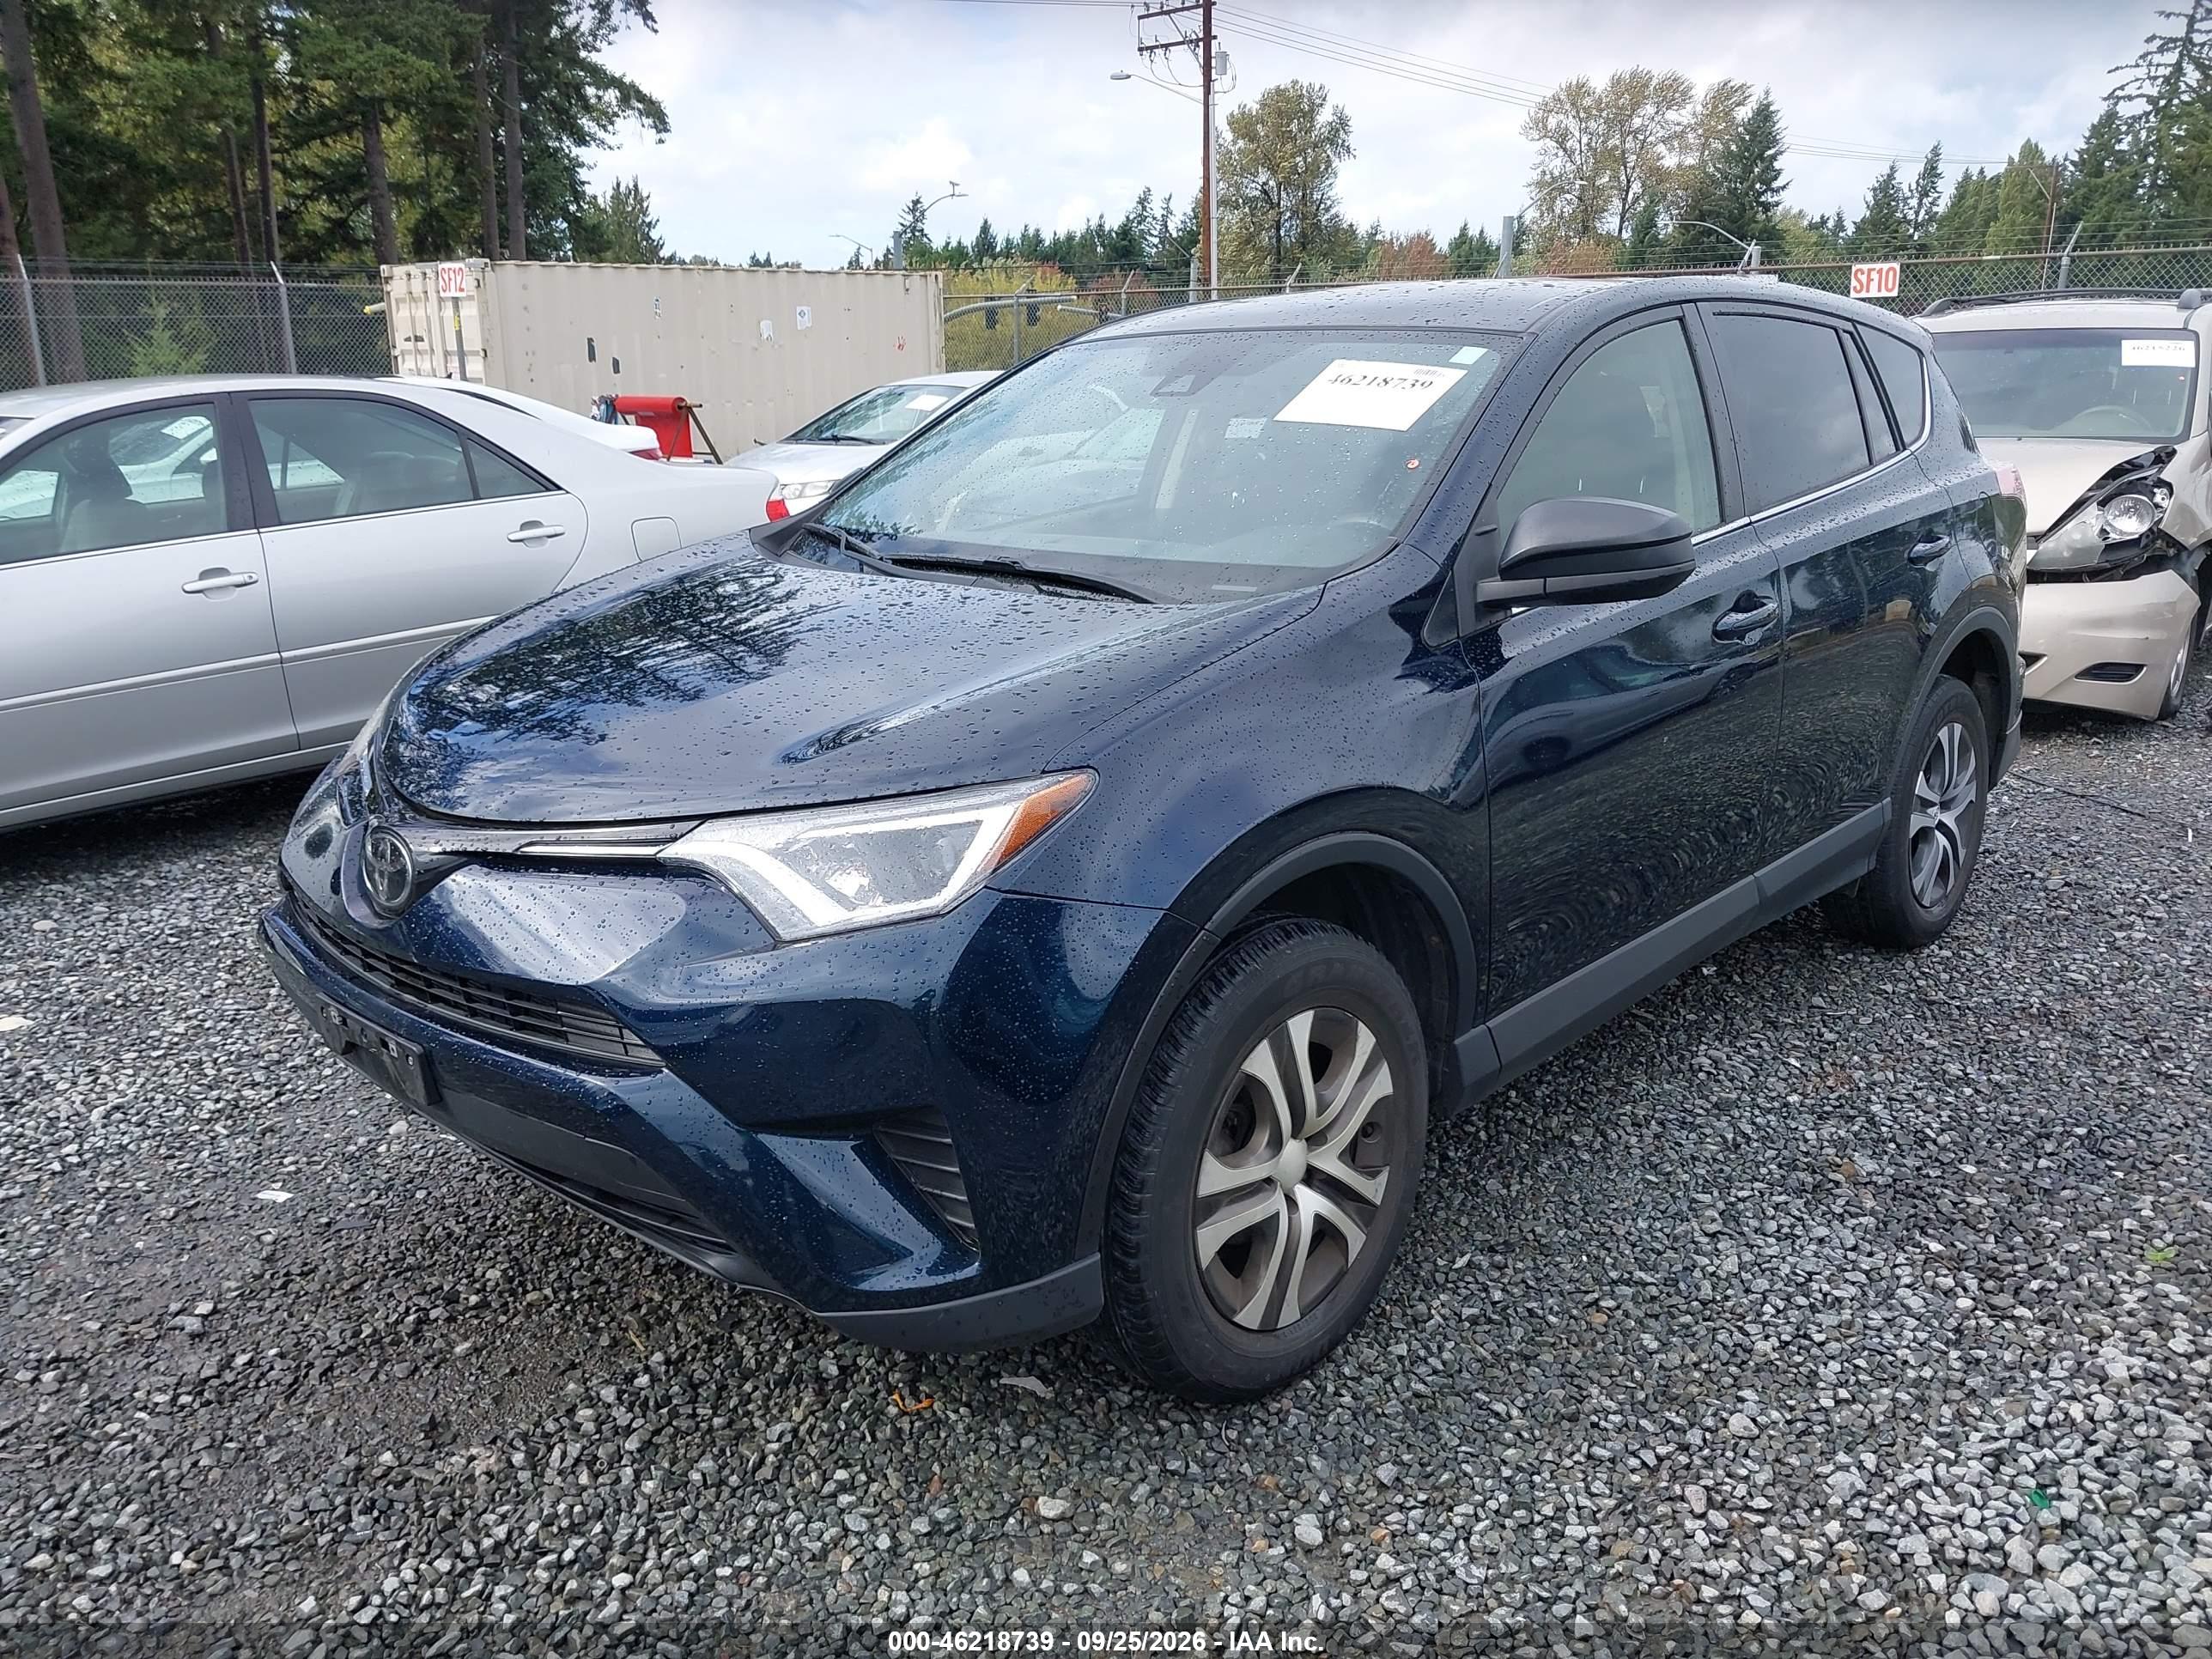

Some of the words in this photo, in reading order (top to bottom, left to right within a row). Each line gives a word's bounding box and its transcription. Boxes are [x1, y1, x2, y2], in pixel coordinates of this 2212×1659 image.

[441, 267, 465, 293] SF12
[1853, 266, 1897, 294] SF10
[1328, 374, 1433, 389] 46218739
